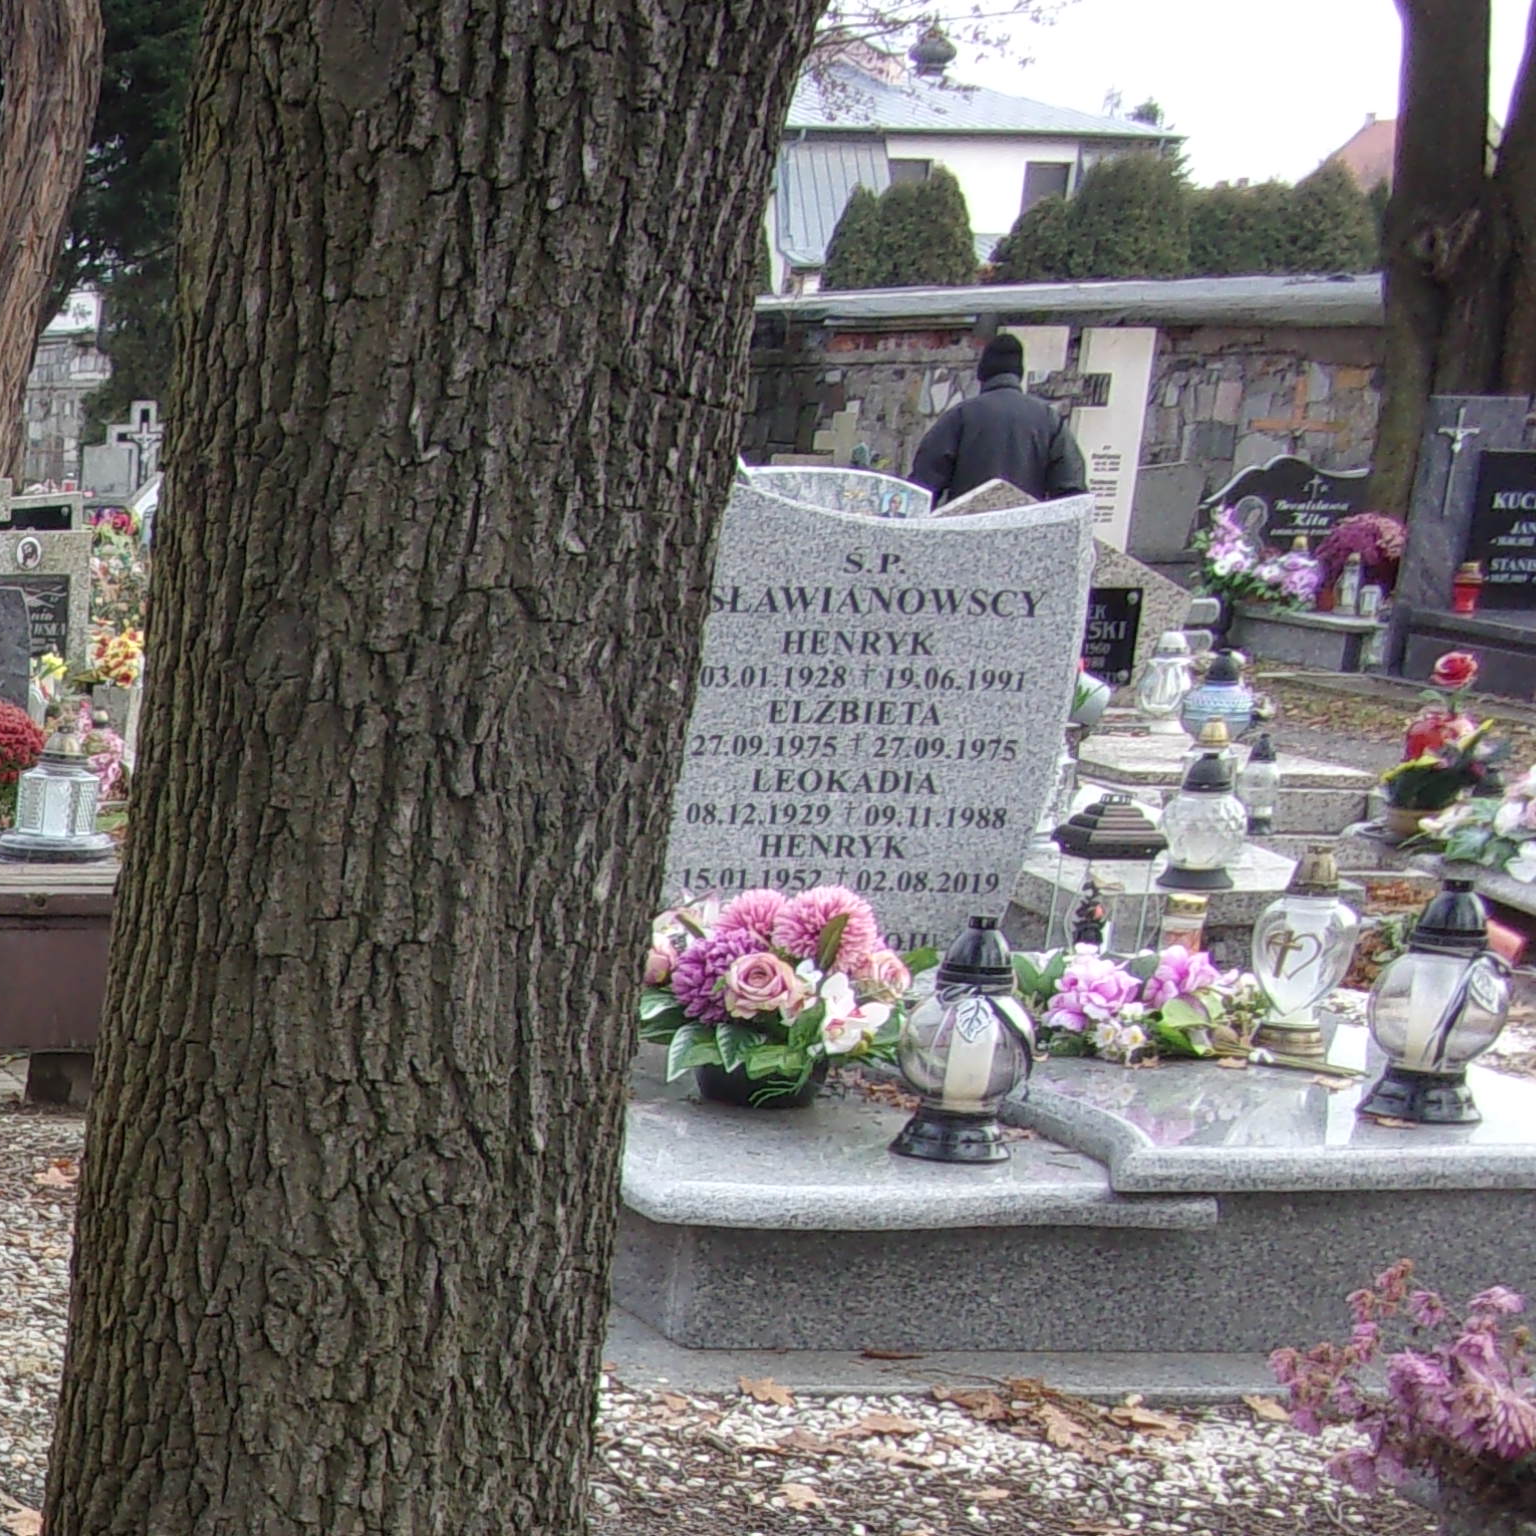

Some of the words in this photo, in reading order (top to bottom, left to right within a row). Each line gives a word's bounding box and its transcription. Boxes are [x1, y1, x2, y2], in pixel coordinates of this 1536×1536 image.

[1492, 492, 1536, 509] KUC
[782, 631, 935, 657] HENRYK
[700, 666, 846, 689] 03.01.1928
[884, 667, 1026, 692] 19.06.1991
[691, 735, 838, 758] 27.09.1975
[874, 737, 1018, 761] 27.09.1975
[752, 769, 939, 795] LEOKADIA
[686, 803, 831, 827] 08.12.1929
[864, 807, 1007, 829] 09.11.1988
[759, 834, 907, 860] HENRYK
[682, 867, 823, 890] 15.01.1952
[856, 872, 999, 894] 02.08.2019
